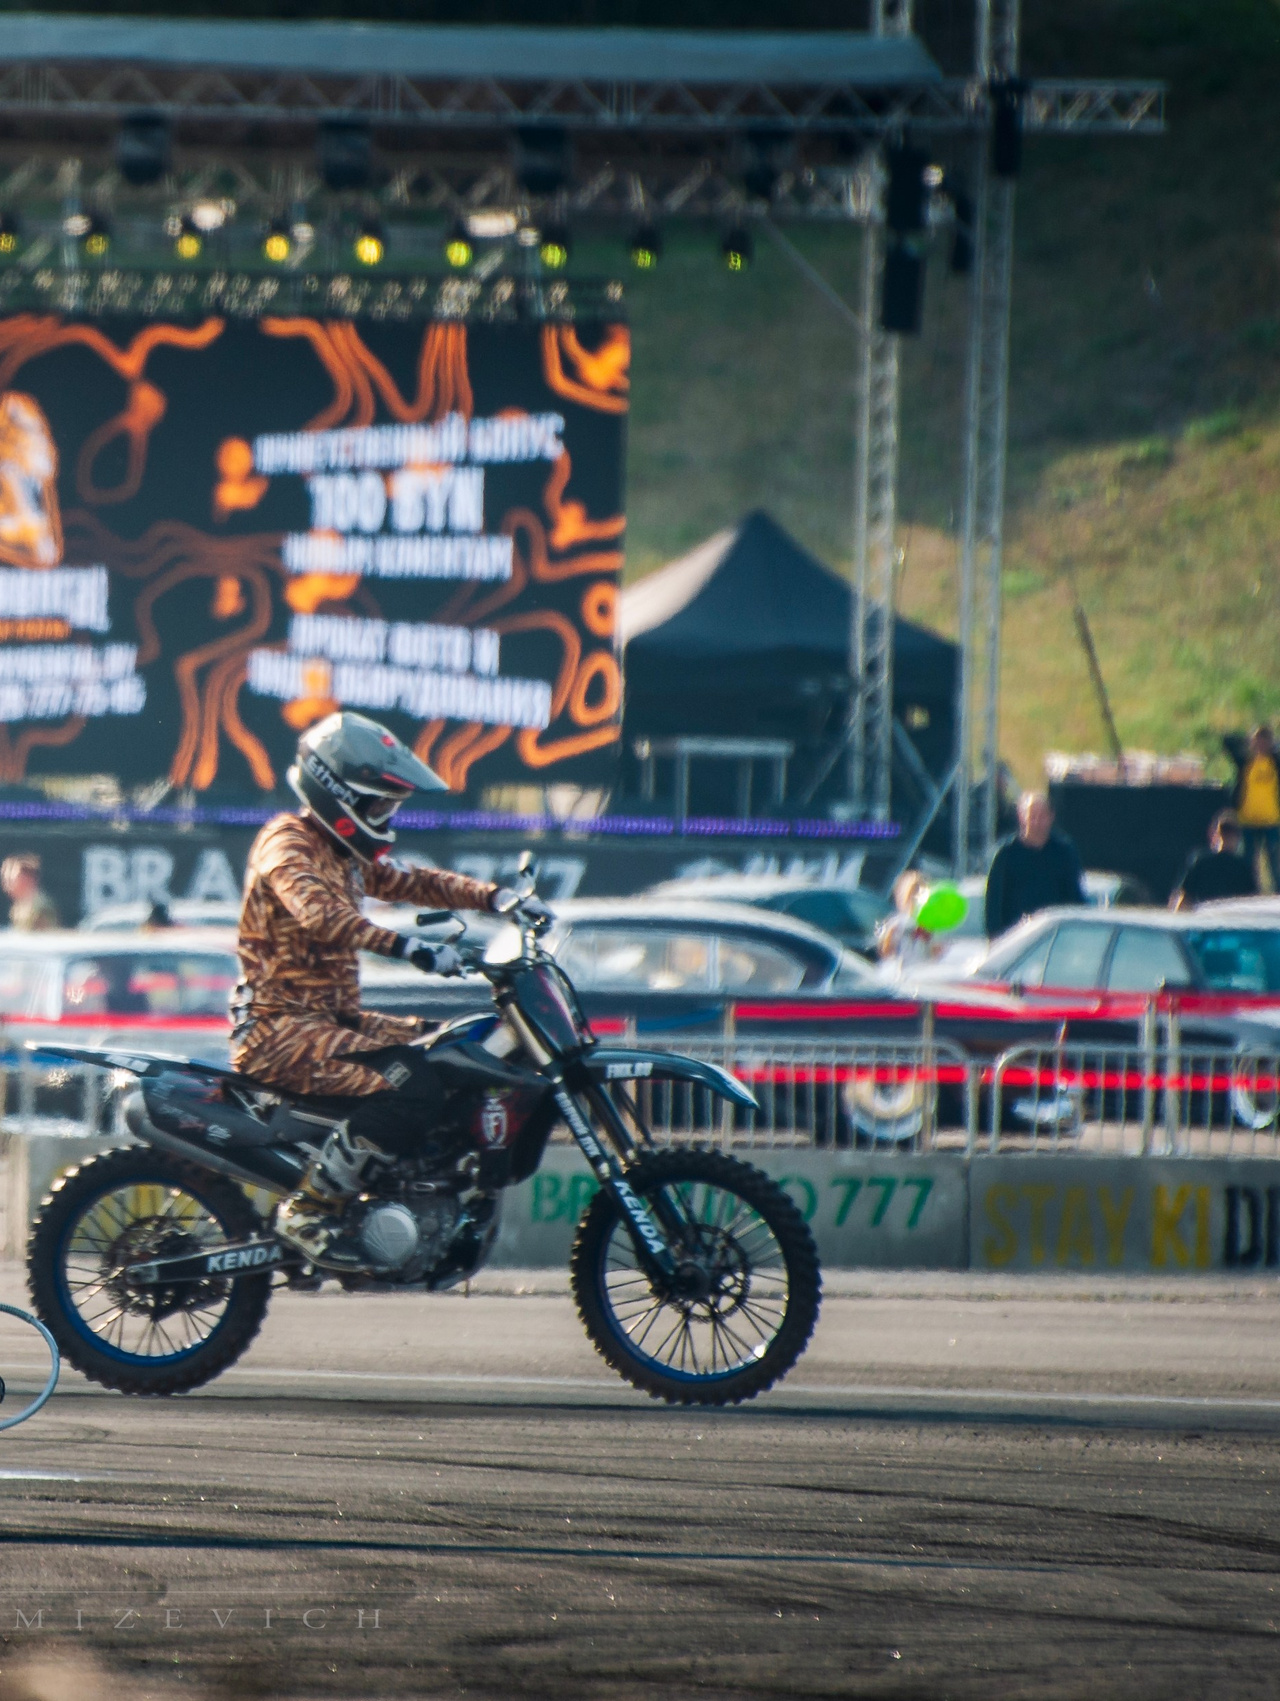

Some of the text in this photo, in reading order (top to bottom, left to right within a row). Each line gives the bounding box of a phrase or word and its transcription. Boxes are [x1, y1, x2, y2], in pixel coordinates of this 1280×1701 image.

[614, 1181, 666, 1254] KENDA
[829, 1175, 934, 1229] 777
[983, 1182, 1134, 1268] STAY
[207, 1245, 283, 1273] KENDA
